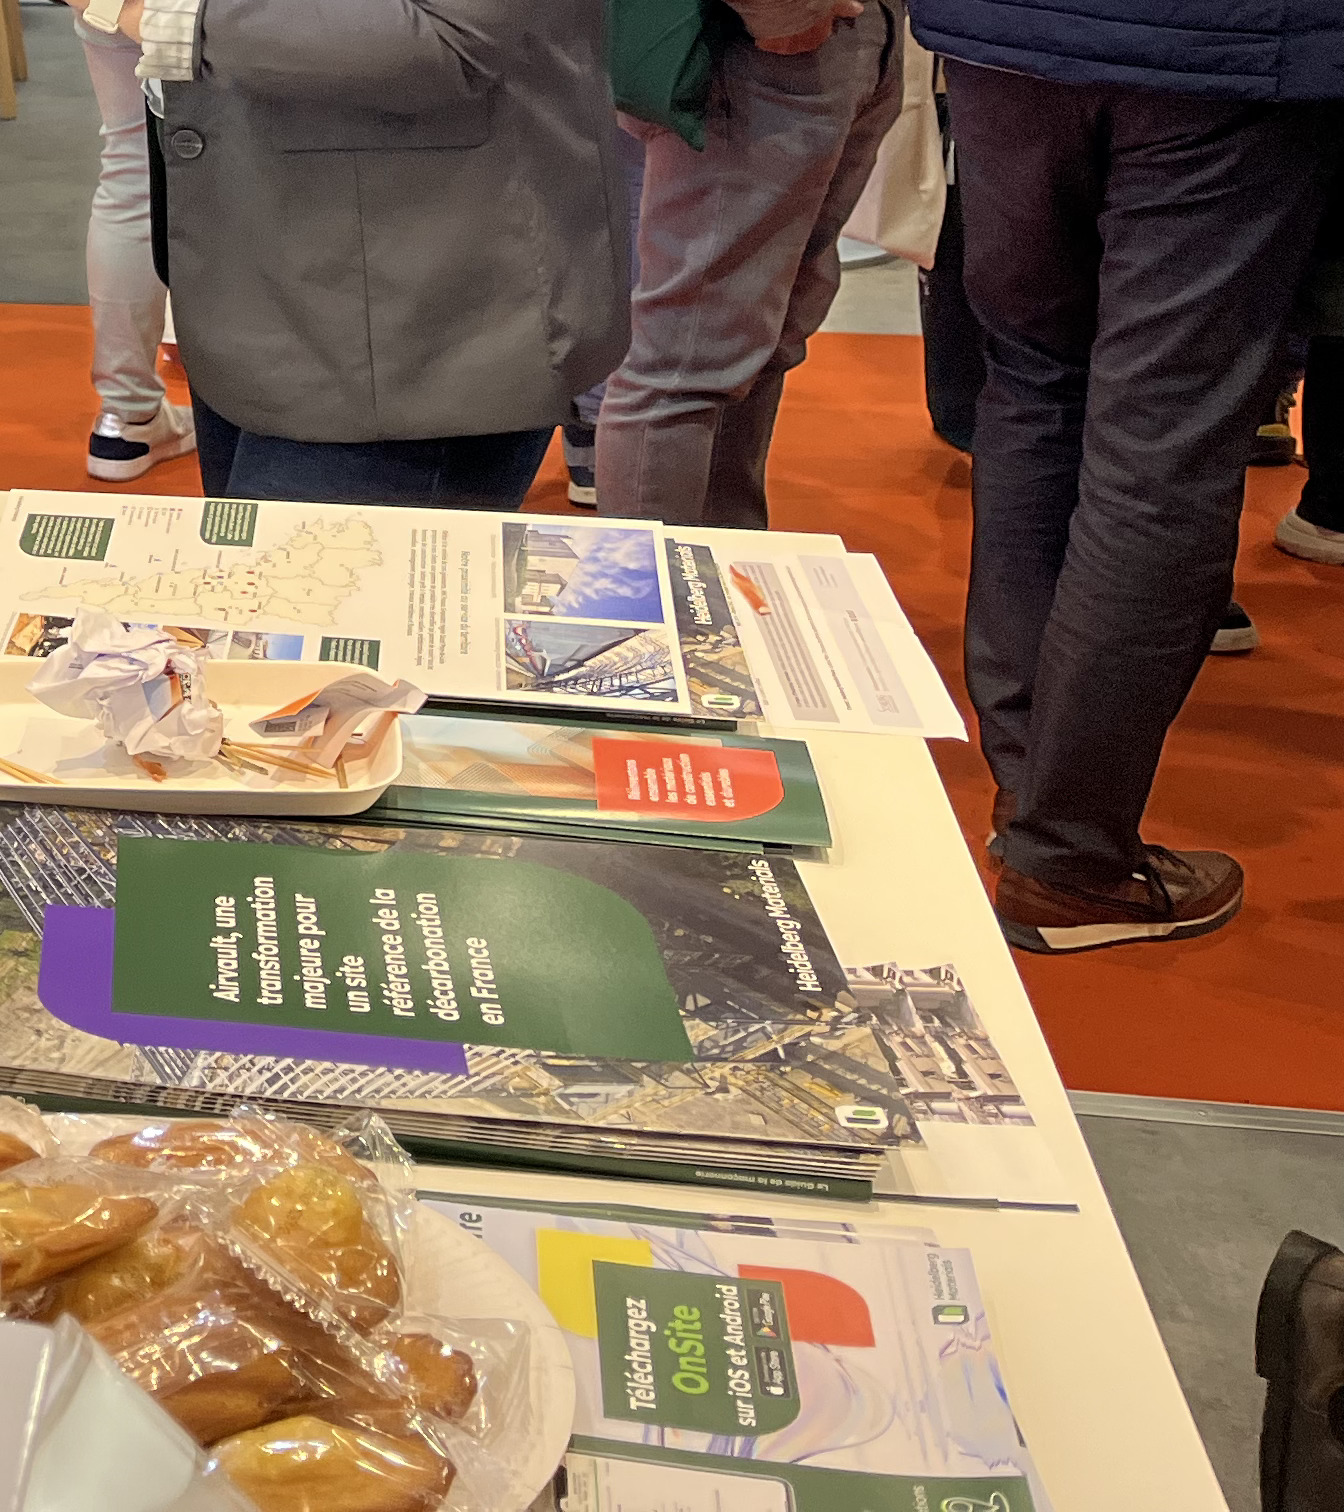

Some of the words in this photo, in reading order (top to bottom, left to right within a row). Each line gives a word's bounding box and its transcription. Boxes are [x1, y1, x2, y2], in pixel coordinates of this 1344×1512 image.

[675, 545, 701, 581] Materials
[686, 581, 713, 625] Heidelberg
[369, 888, 396, 905] la
[747, 859, 791, 918] Materials
[214, 895, 236, 928] une
[294, 893, 327, 936] pour
[371, 908, 401, 931] de
[246, 875, 284, 1006] transformation
[410, 891, 461, 1022] décarbonation
[776, 918, 823, 992] Heidelberg
[209, 932, 244, 1003] Airvault,
[293, 938, 331, 1010] majeure
[335, 954, 368, 988] site
[379, 936, 416, 1018] référence
[465, 937, 502, 1000] France
[346, 989, 371, 1013] un
[480, 1002, 506, 1026] en
[695, 1170, 756, 1183] maçonnerie
[757, 1176, 768, 1185] la
[770, 1178, 783, 1186] de
[785, 1179, 815, 1190] Guide
[817, 1183, 829, 1191] Le
[926, 1253, 945, 1300] Heidelberg
[942, 1259, 960, 1300] Materials
[715, 1284, 745, 1347] Android
[624, 1296, 657, 1411] Téléchargez
[664, 1304, 710, 1395] OnSite
[725, 1348, 748, 1366] et
[727, 1368, 753, 1398] iOS
[773, 1369, 784, 1385] App
[736, 1399, 757, 1428] sur
